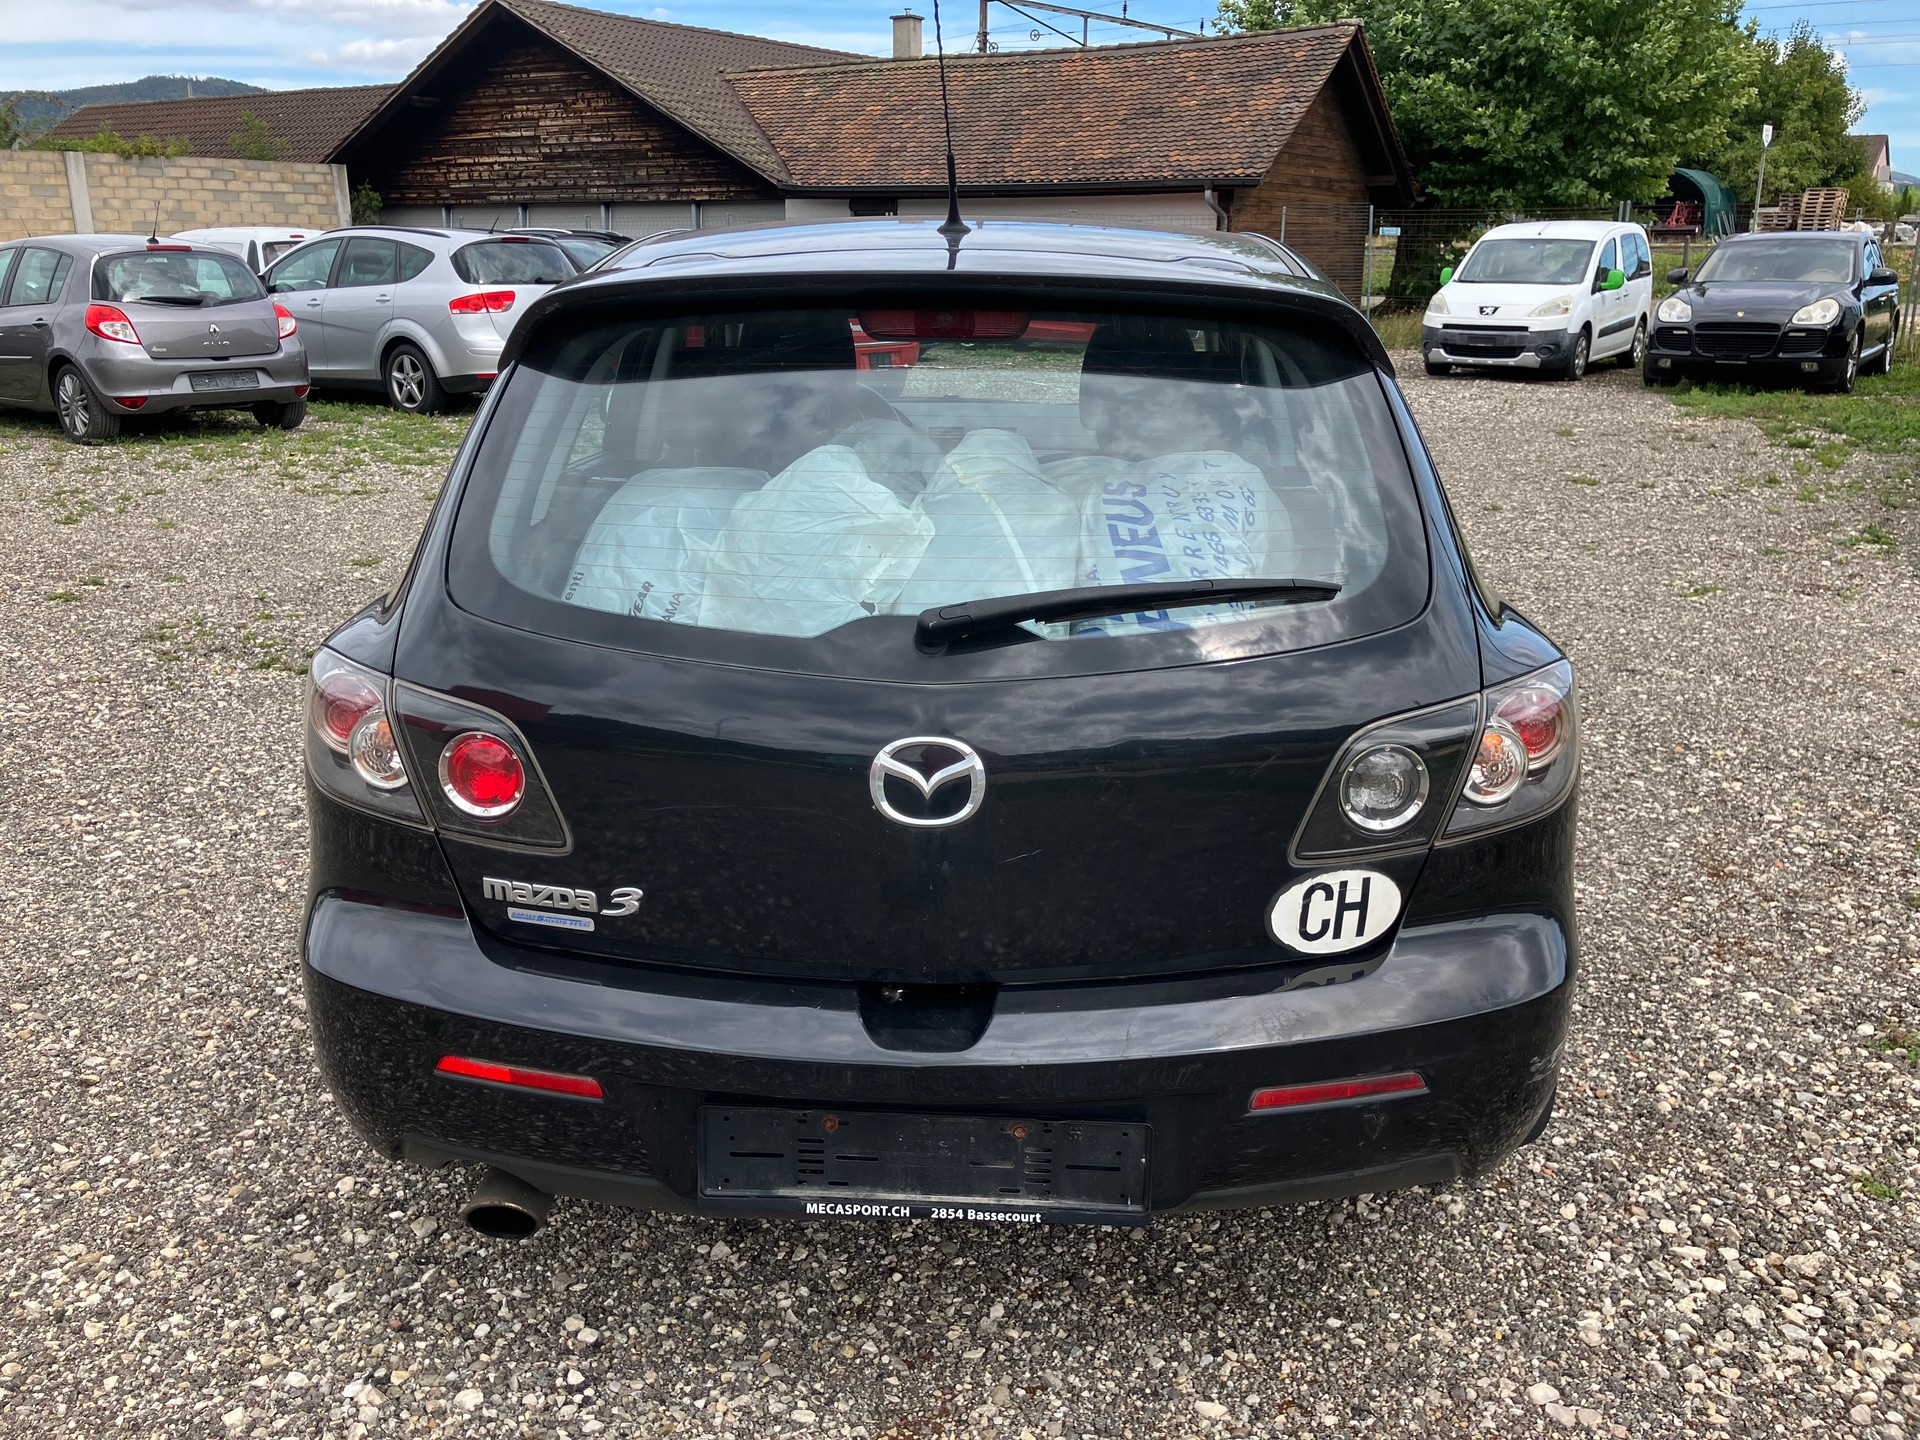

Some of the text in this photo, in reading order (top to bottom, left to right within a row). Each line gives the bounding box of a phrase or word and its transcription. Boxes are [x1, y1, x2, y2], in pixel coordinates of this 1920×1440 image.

[600, 887, 644, 917] 3
[1298, 876, 1372, 942] CH
[806, 1203, 1042, 1223] MECASPORT.CH 2854 Bassecourt
